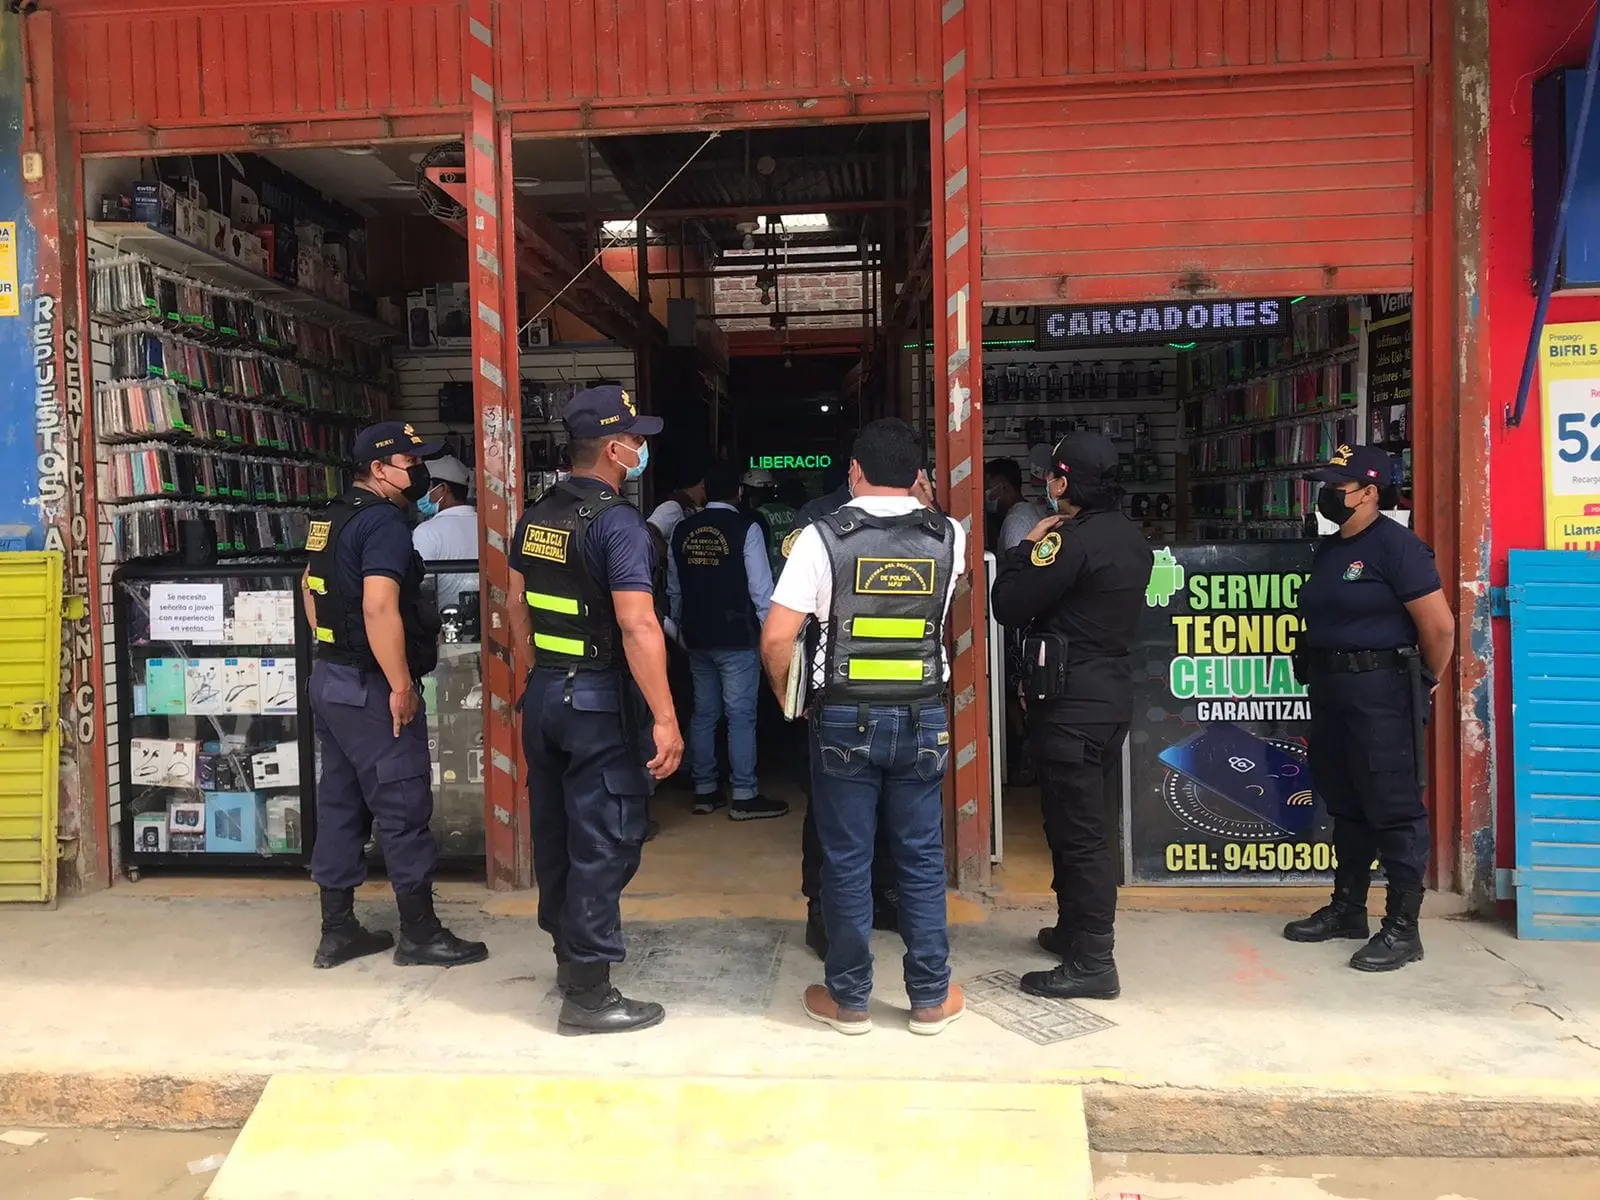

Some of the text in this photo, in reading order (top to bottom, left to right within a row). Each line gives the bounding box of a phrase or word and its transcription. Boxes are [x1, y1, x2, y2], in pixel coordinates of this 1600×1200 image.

[1046, 300, 1280, 337] CARGADORES
[1549, 345, 1586, 357] BIFRI
[34, 295, 66, 502] REPUESTOS
[64, 329, 88, 542] SERVICIO
[375, 438, 395, 449] PERU
[749, 455, 832, 469] LIBERACIO
[524, 541, 564, 559] MUNICIPAL
[529, 529, 563, 547] POLICIA
[1188, 573, 1311, 610] SERVIC
[1172, 614, 1307, 654] TECNIC
[1170, 655, 1309, 699] CELULA
[1166, 843, 1217, 871] CEL:
